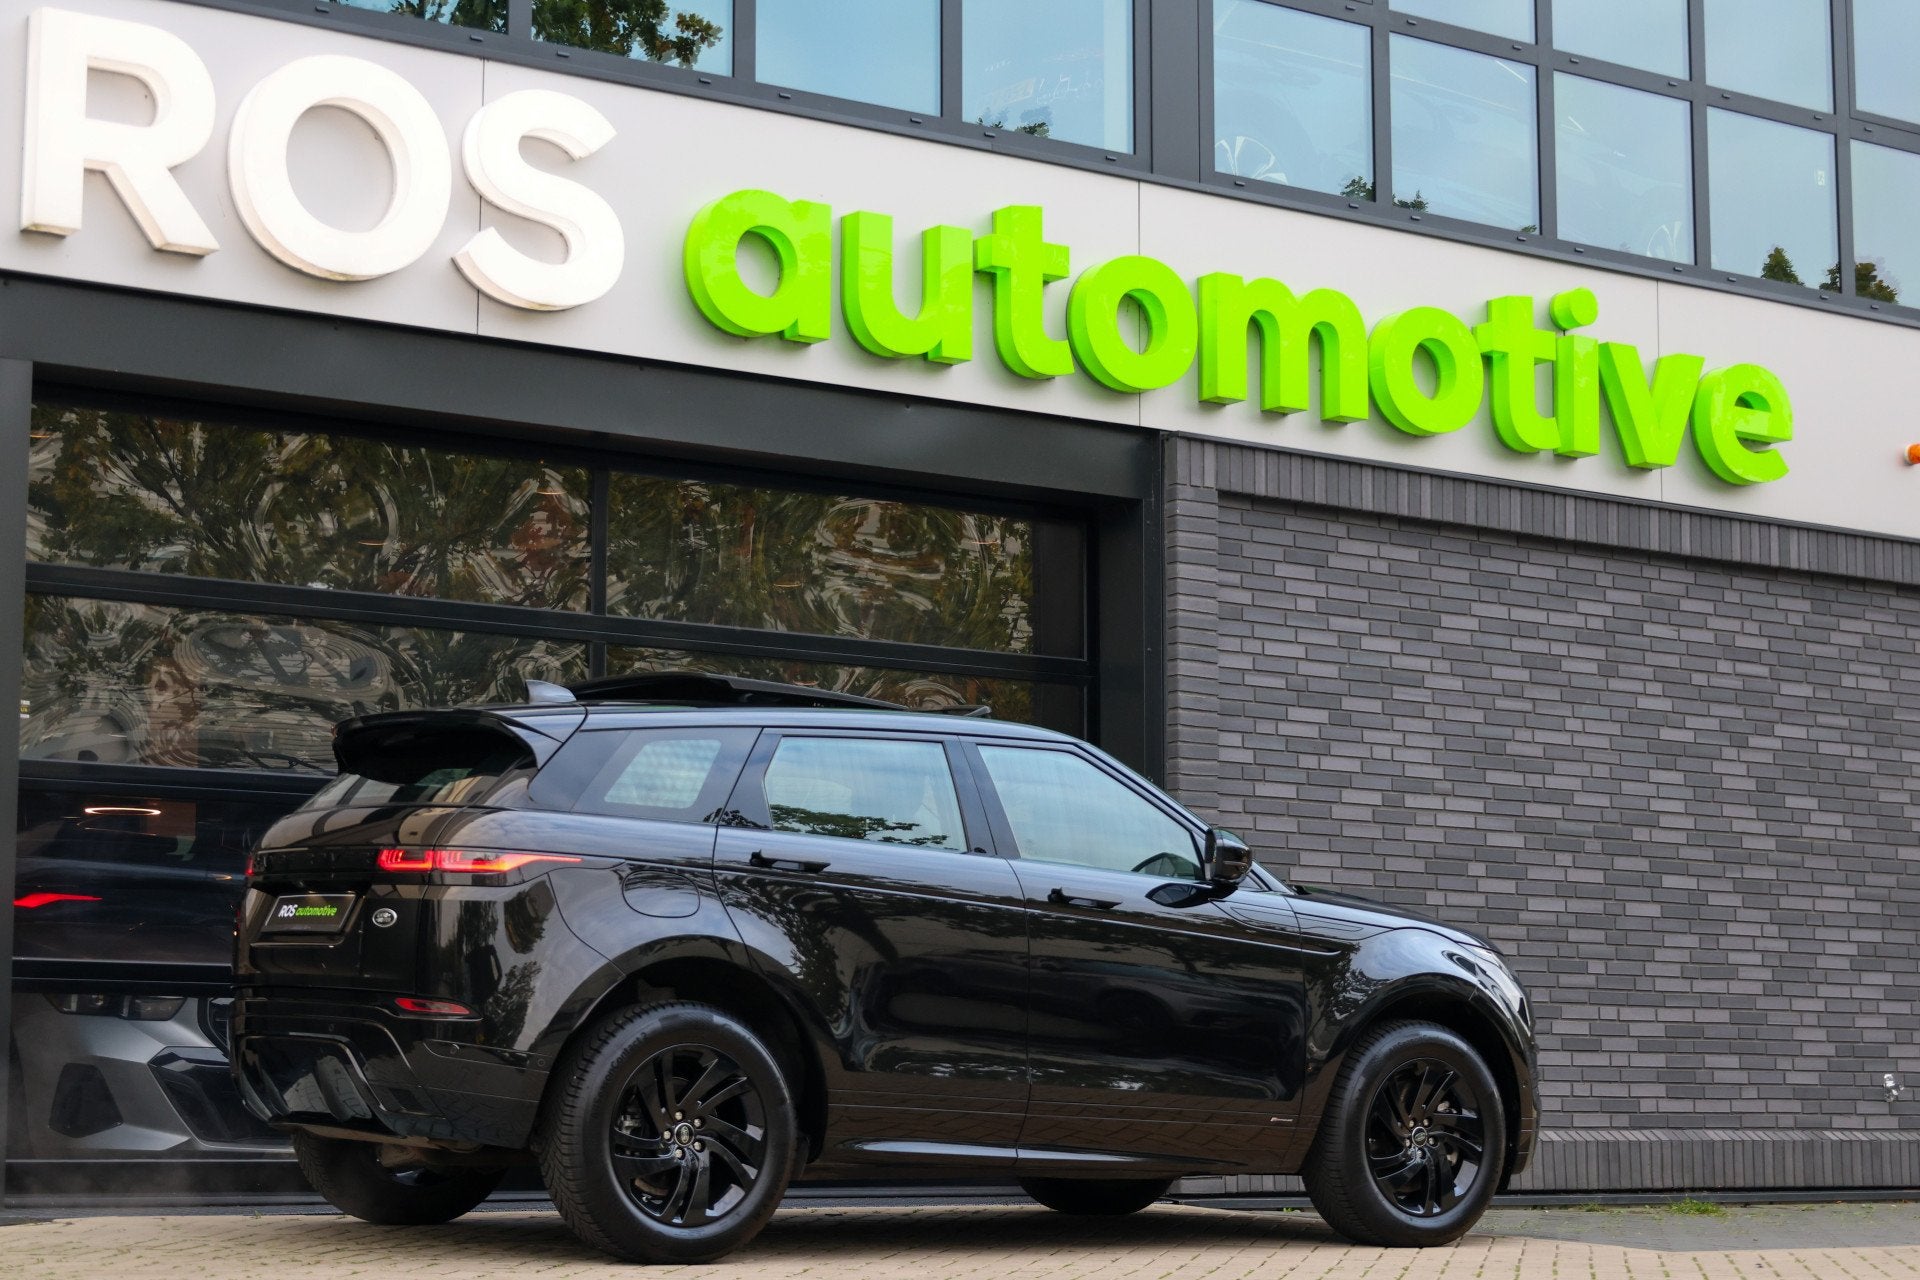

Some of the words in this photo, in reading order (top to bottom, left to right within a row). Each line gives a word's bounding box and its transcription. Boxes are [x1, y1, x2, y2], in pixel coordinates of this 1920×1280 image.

[20, 6, 625, 312] ROS
[684, 188, 1794, 485] automotive
[278, 904, 298, 917] ROS
[296, 905, 338, 917] automotive
